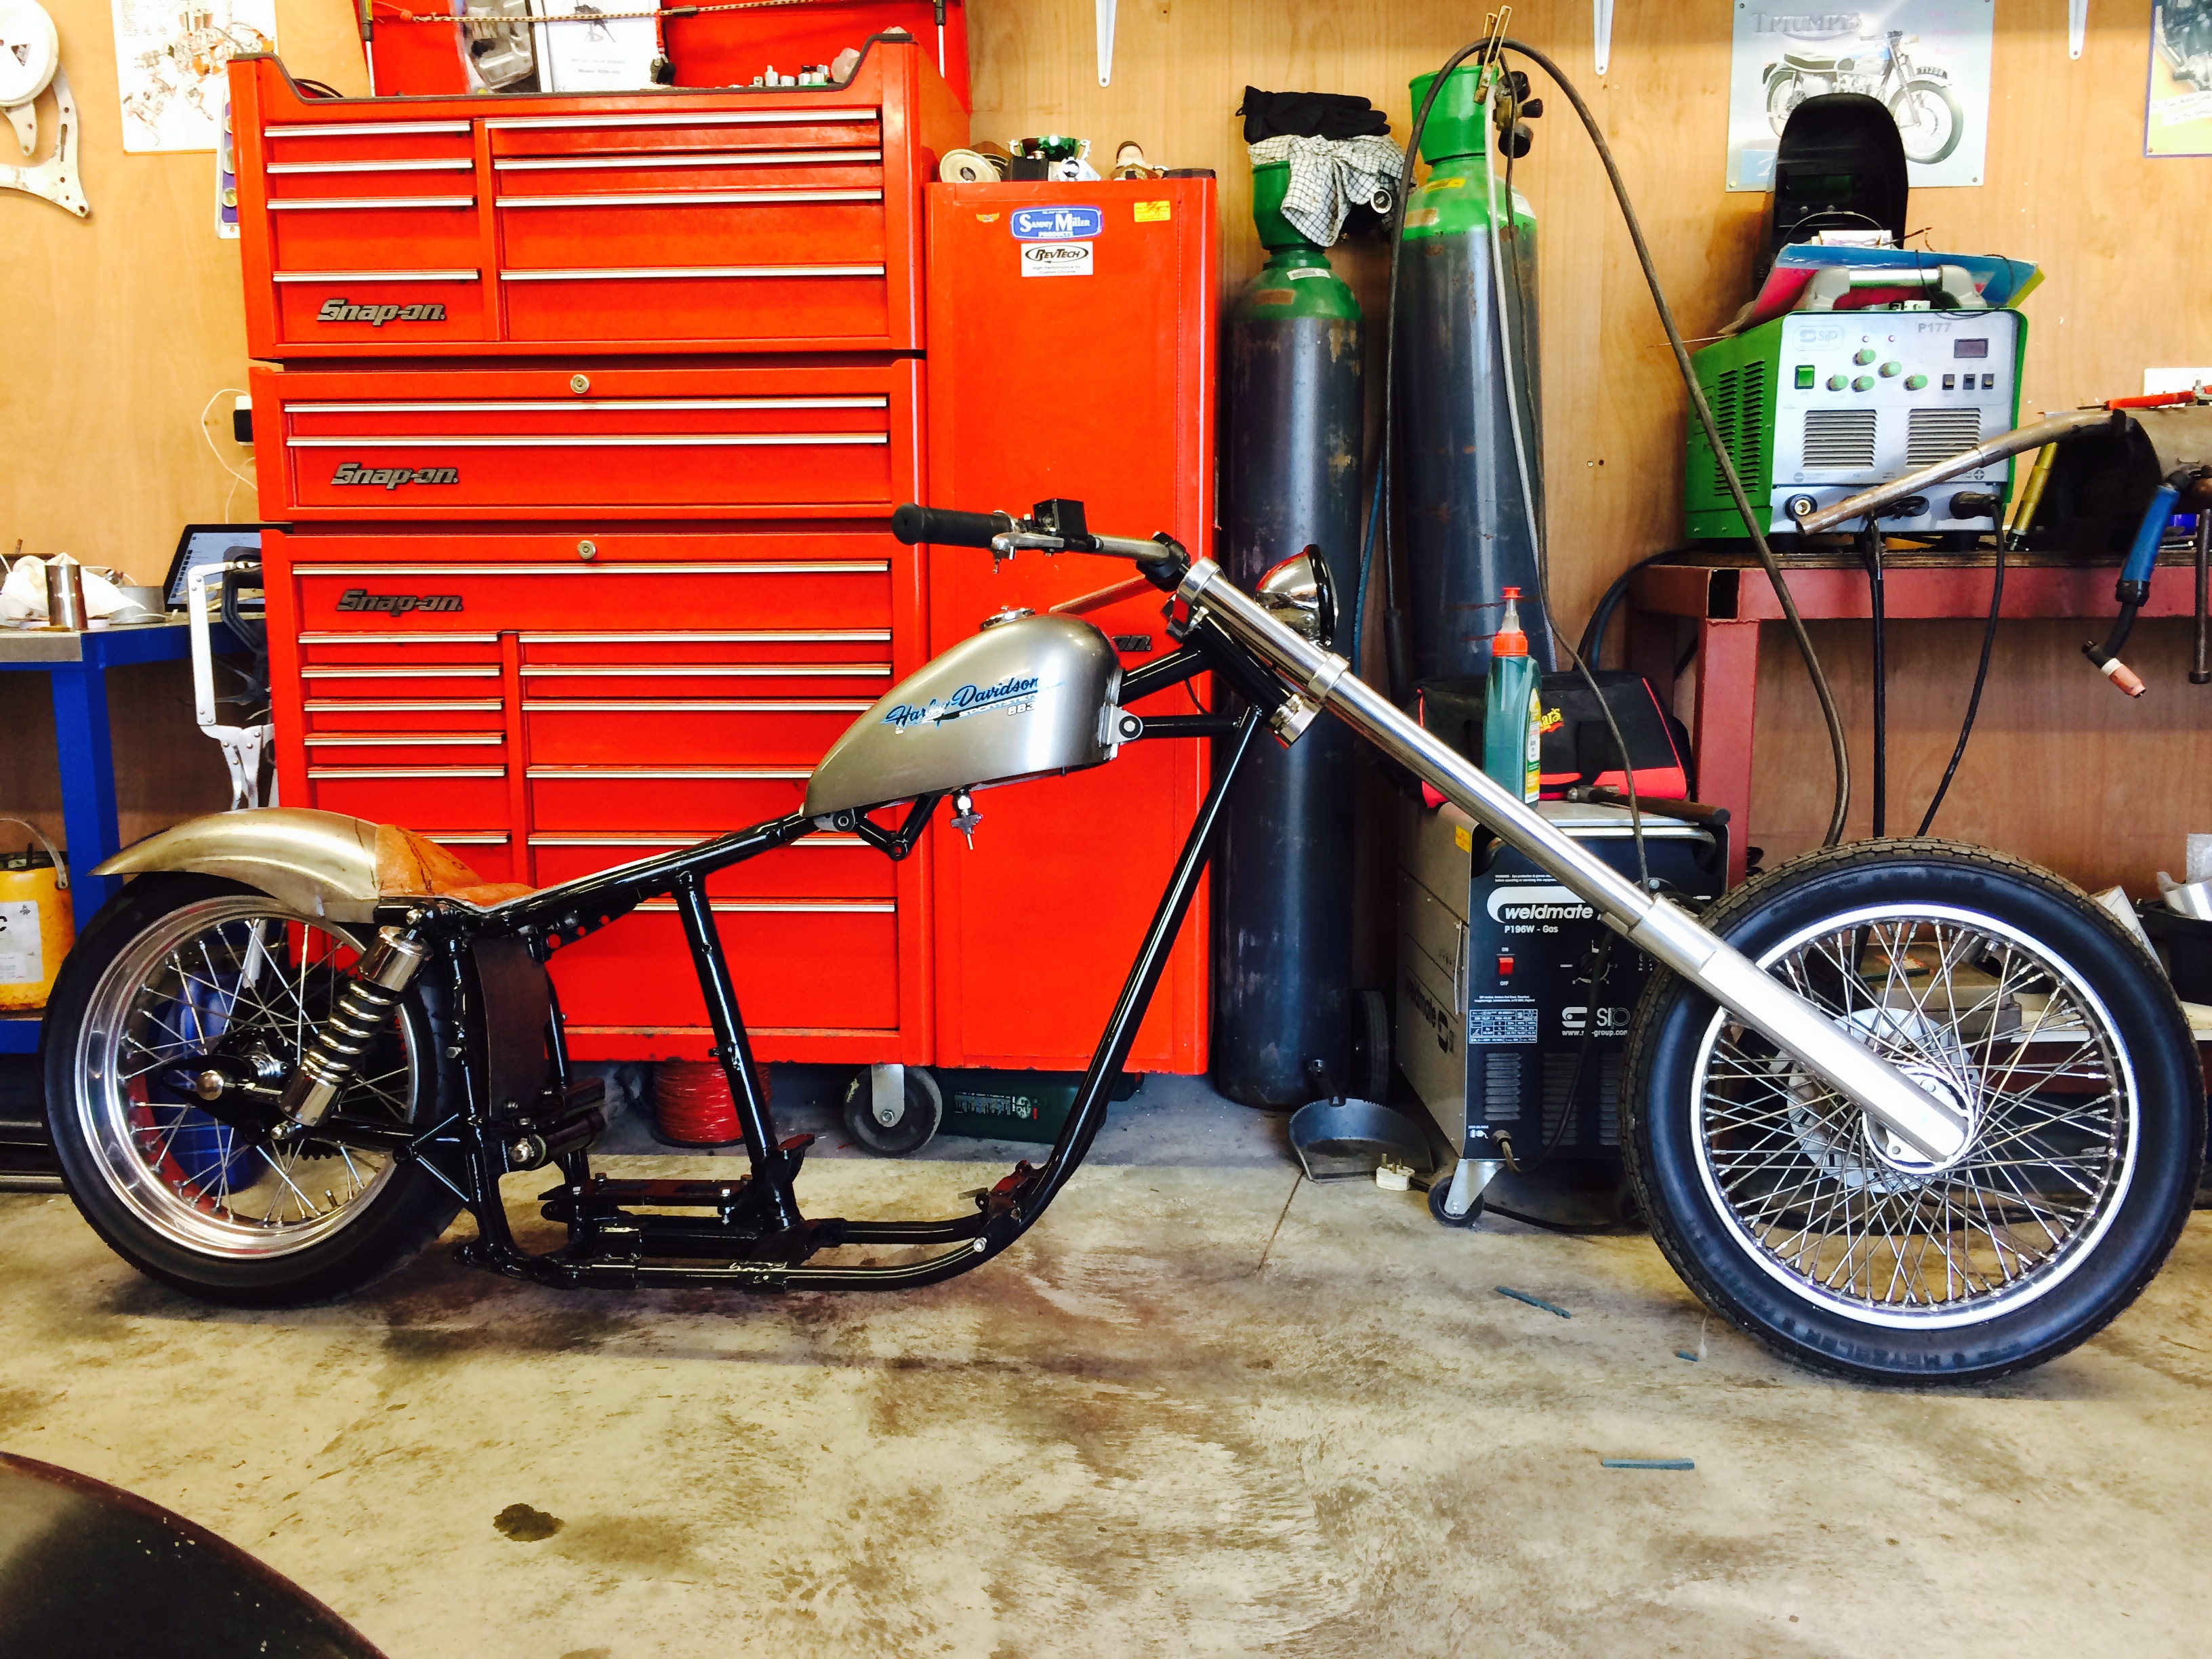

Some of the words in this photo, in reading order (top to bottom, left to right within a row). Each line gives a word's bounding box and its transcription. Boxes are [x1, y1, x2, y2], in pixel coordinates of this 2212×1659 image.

[1919, 323, 1951, 333] P177
[1007, 701, 1036, 716] 883
[1505, 905, 1593, 920] weldmate
[1504, 925, 1534, 933] P196W
[1542, 925, 1558, 933] Gas
